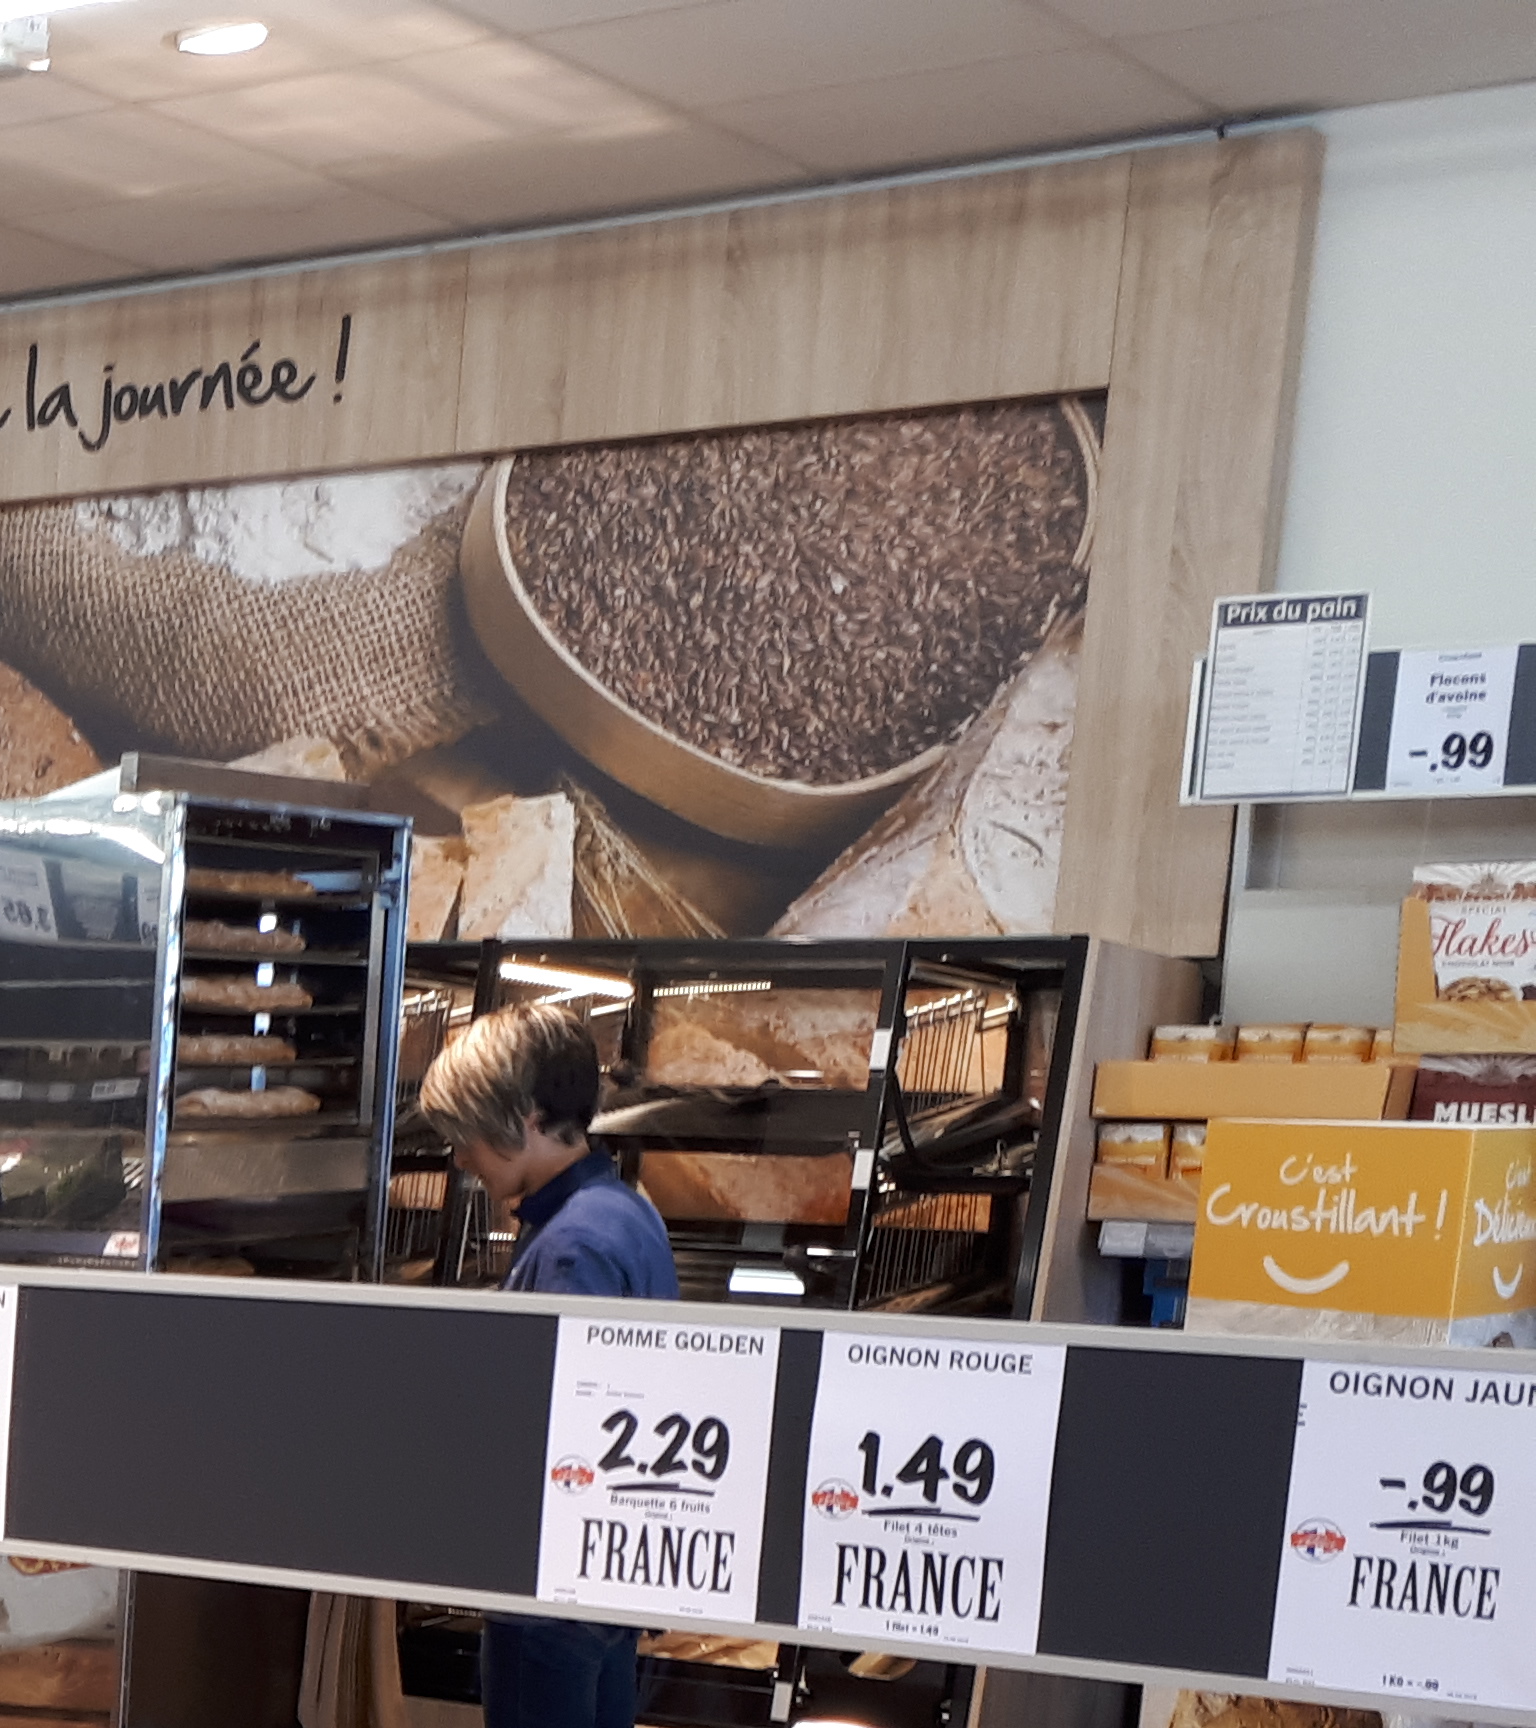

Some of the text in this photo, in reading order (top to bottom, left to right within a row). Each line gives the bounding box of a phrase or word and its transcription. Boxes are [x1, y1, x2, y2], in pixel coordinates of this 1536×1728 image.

[23, 343, 77, 432] la
[78, 339, 318, 452] journée
[1226, 596, 1357, 623] Prix du pain
[1425, 689, 1487, 704] d'avoine
[1429, 671, 1487, 687] Flocons
[1408, 731, 1494, 773] -.99
[1431, 915, 1529, 957] Flakes
[1279, 1151, 1358, 1185] C'est
[1206, 1184, 1426, 1238] Croustillant
[586, 1324, 764, 1355] POMME GOLDEN
[847, 1343, 1034, 1375] OIGNON ROUGE
[1329, 1370, 1455, 1401] OIGNON
[597, 1408, 730, 1481] 2.29
[858, 1430, 995, 1505] 1.49
[609, 1494, 665, 1511] Barquette
[680, 1500, 711, 1514] fruits
[1380, 1460, 1495, 1517] -.99
[883, 1519, 910, 1535] Filet
[1400, 1531, 1429, 1546] Filet
[577, 1516, 736, 1595] FRANCE
[832, 1542, 1004, 1622] FRANCE
[1347, 1553, 1501, 1621] FRANCE
